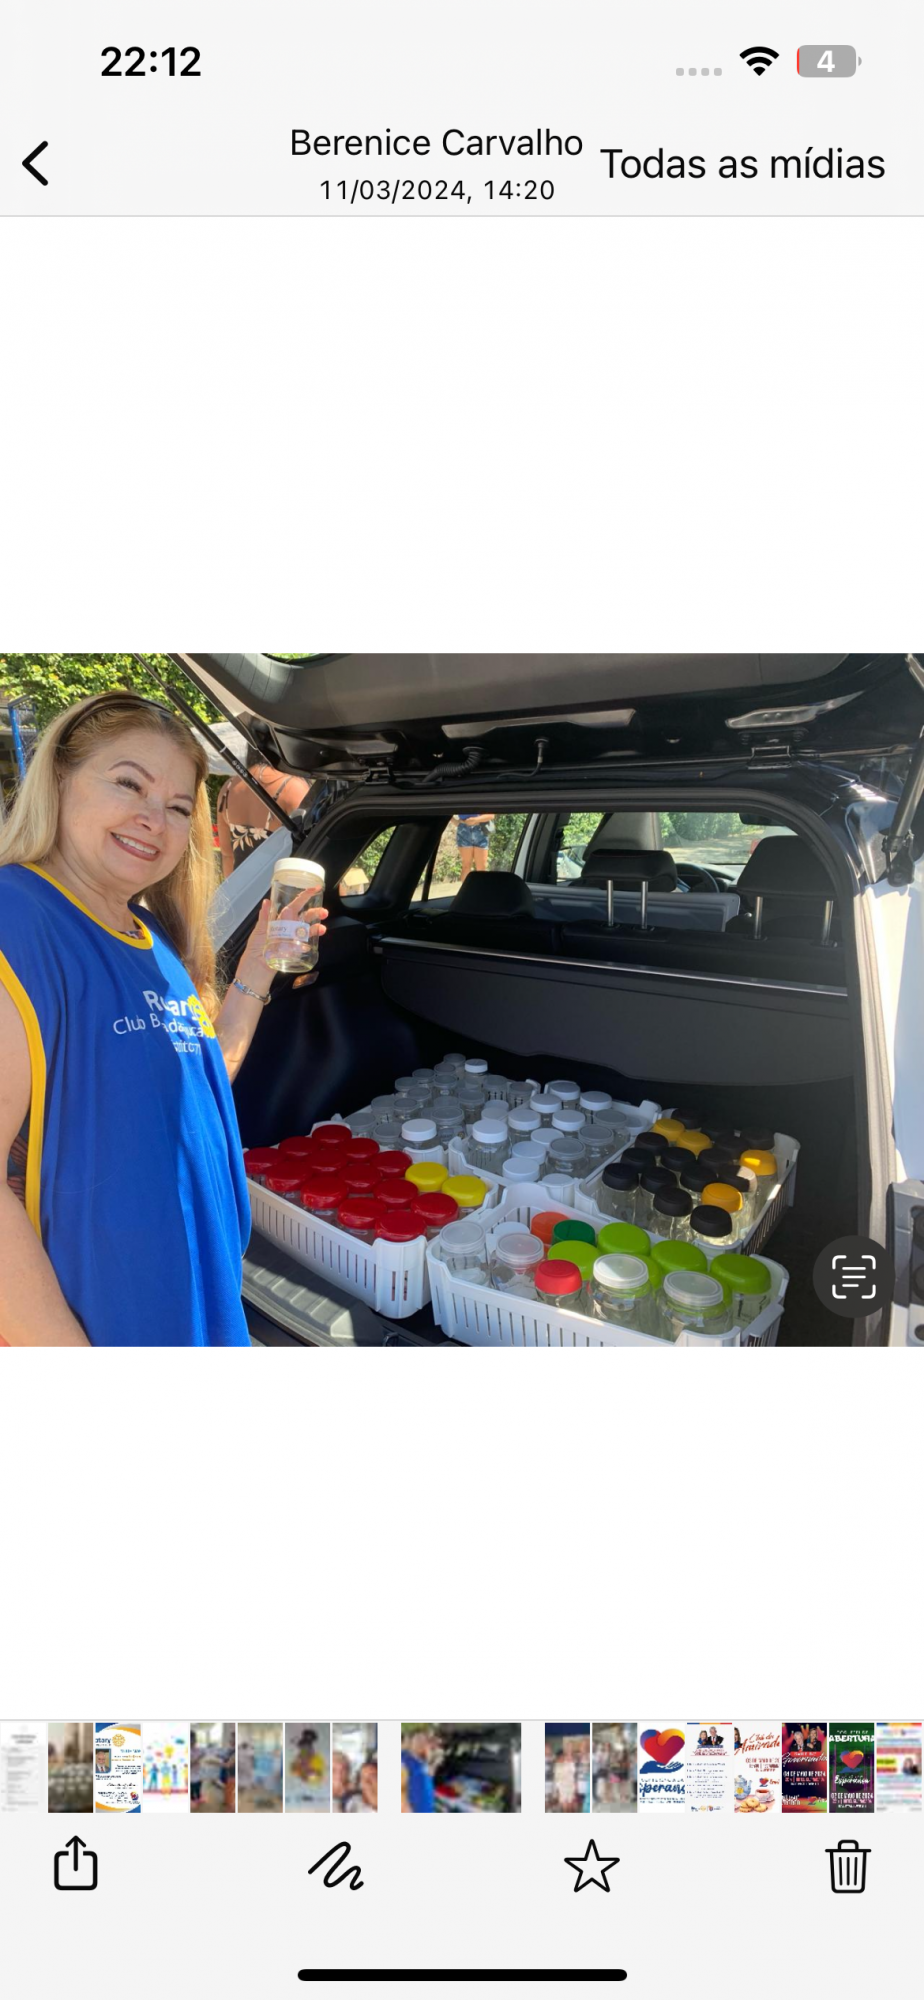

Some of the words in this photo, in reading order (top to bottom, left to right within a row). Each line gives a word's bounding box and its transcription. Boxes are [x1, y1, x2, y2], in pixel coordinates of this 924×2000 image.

[101, 47, 201, 76] 22:12
[817, 51, 835, 72] 4
[291, 128, 431, 156] Berenice
[442, 128, 583, 157] Carvalho
[600, 148, 706, 179] Todas
[719, 156, 758, 179] as
[770, 147, 886, 179] mídias
[320, 180, 474, 205] 11/03/2024,
[484, 180, 555, 201] 14:20
[142, 990, 199, 1021] Rary
[113, 1015, 146, 1035] Club
